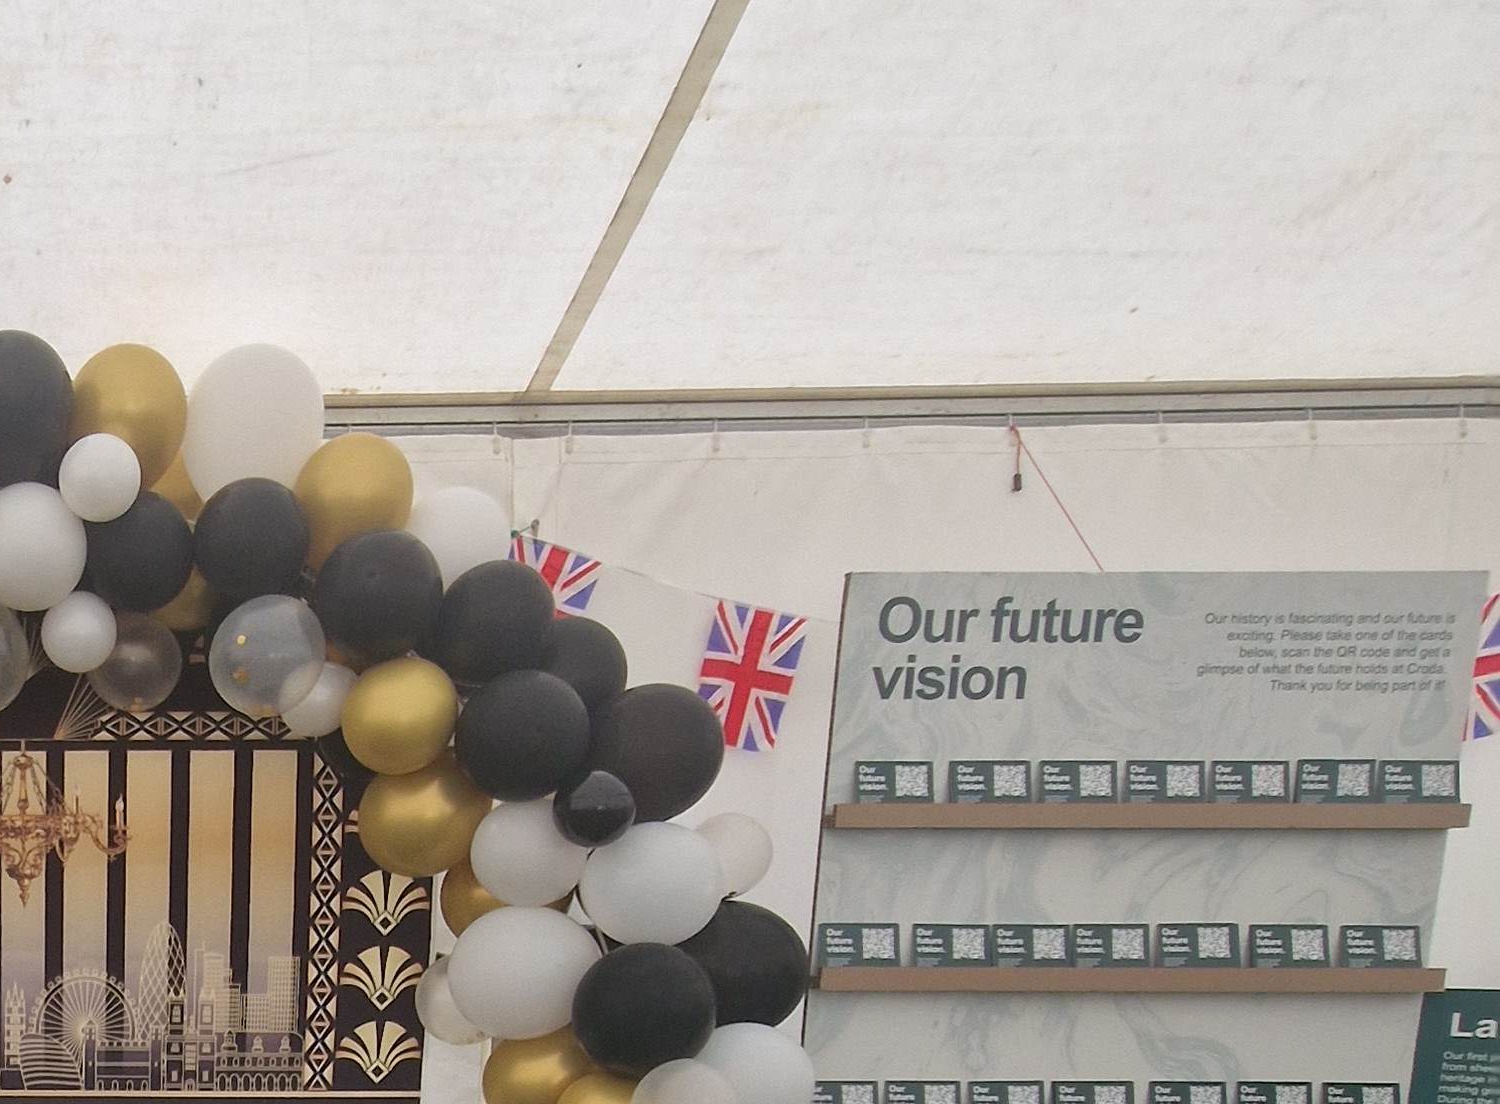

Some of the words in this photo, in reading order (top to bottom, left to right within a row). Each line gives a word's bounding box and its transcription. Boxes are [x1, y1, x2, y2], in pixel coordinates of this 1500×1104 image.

[878, 595, 979, 645] Our
[989, 595, 1145, 645] future
[1204, 613, 1228, 625] Our
[1231, 612, 1272, 628] history
[1274, 613, 1285, 625] is
[1288, 612, 1354, 628] fascinating
[1357, 613, 1381, 625] and
[1384, 615, 1403, 625] our
[1407, 612, 1442, 625] future
[1446, 612, 1456, 625] is
[1227, 628, 1275, 645] exciting.
[1280, 629, 1323, 642] Please
[1325, 629, 1352, 642] take
[1355, 632, 1378, 642] one
[1381, 629, 1395, 642] of
[1397, 629, 1416, 642] the
[1419, 629, 1454, 642] cards
[1238, 645, 1278, 660] below,
[1281, 649, 1311, 659] scan
[1313, 645, 1333, 658] the
[1336, 646, 1357, 659] QR
[1360, 645, 1390, 658] code
[1393, 645, 1417, 658] and
[1419, 646, 1442, 661] get
[1443, 648, 1452, 658] a
[1196, 662, 1244, 678] glimpse
[1247, 662, 1260, 675] of
[1262, 662, 1292, 675] what
[1294, 662, 1314, 675] the
[1317, 662, 1353, 675] future
[1355, 662, 1388, 675] holds
[1391, 663, 1403, 675] at
[871, 654, 1028, 701] vision
[1269, 679, 1307, 692] Thank
[1310, 682, 1333, 694] you
[1335, 679, 1353, 692] for
[1355, 679, 1388, 694] being
[1391, 680, 1416, 694] part
[1419, 679, 1432, 692] of
[1433, 679, 1446, 692] it!
[859, 765, 876, 773] Our
[957, 765, 974, 773] Our
[1043, 765, 1061, 773] Our
[1130, 765, 1147, 773] Our
[1215, 765, 1233, 773] Our
[1302, 764, 1320, 772] Our
[1385, 765, 1402, 773] Our
[859, 774, 886, 782] future
[957, 774, 984, 782] future
[1043, 774, 1071, 782] future
[1130, 774, 1157, 782] future
[1215, 774, 1243, 782] future
[1302, 773, 1330, 781] future
[1385, 774, 1412, 782] future
[859, 782, 888, 791] vision.
[957, 782, 987, 791] vision.
[1043, 782, 1073, 791] vision.
[1130, 782, 1160, 791] vision.
[1215, 782, 1245, 791] vision.
[1302, 781, 1332, 790] vision.
[1385, 782, 1414, 791] vision.
[1450, 1011, 1499, 1038] La
[1443, 1050, 1464, 1060] Our
